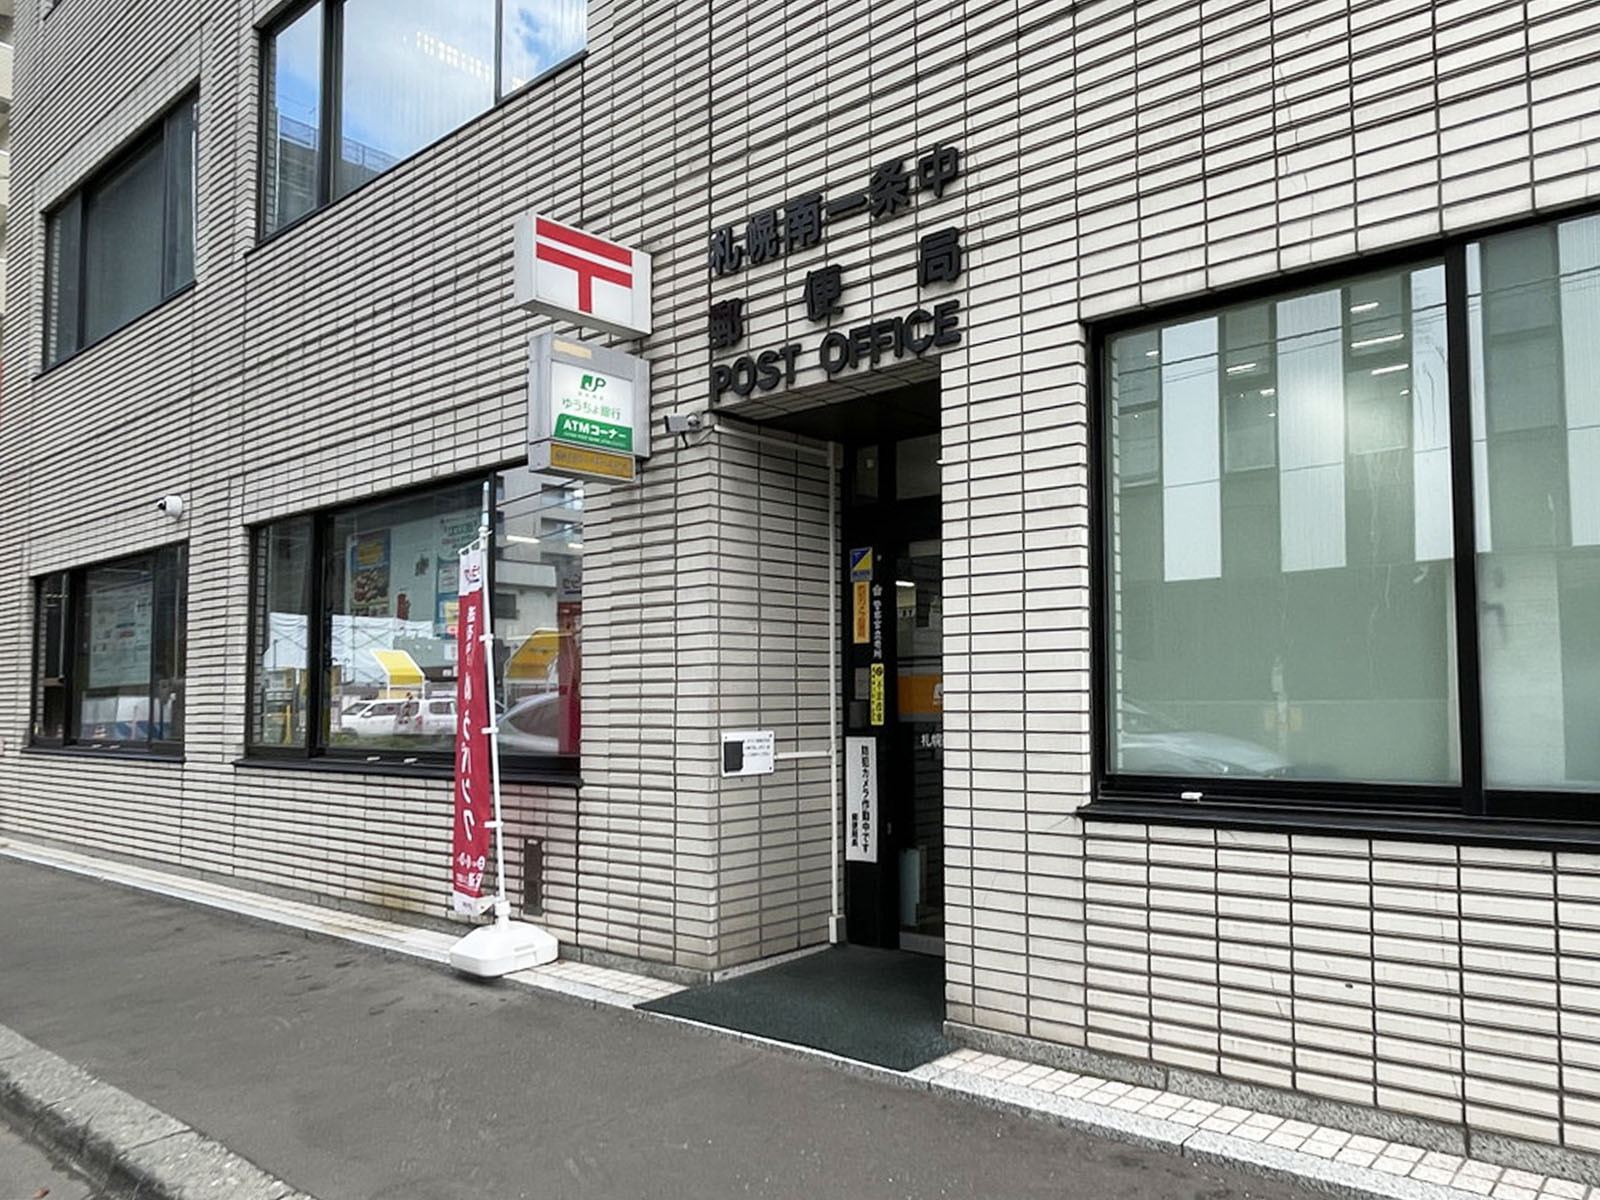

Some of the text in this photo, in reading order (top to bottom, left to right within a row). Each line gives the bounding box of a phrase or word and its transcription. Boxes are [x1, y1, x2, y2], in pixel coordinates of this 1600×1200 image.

[709, 142, 959, 276] 札幌南一条中
[709, 299, 962, 403] POST OFFICE
[562, 398, 622, 421] ゆうちょ銀行
[563, 419, 627, 439] ATMコーナー
